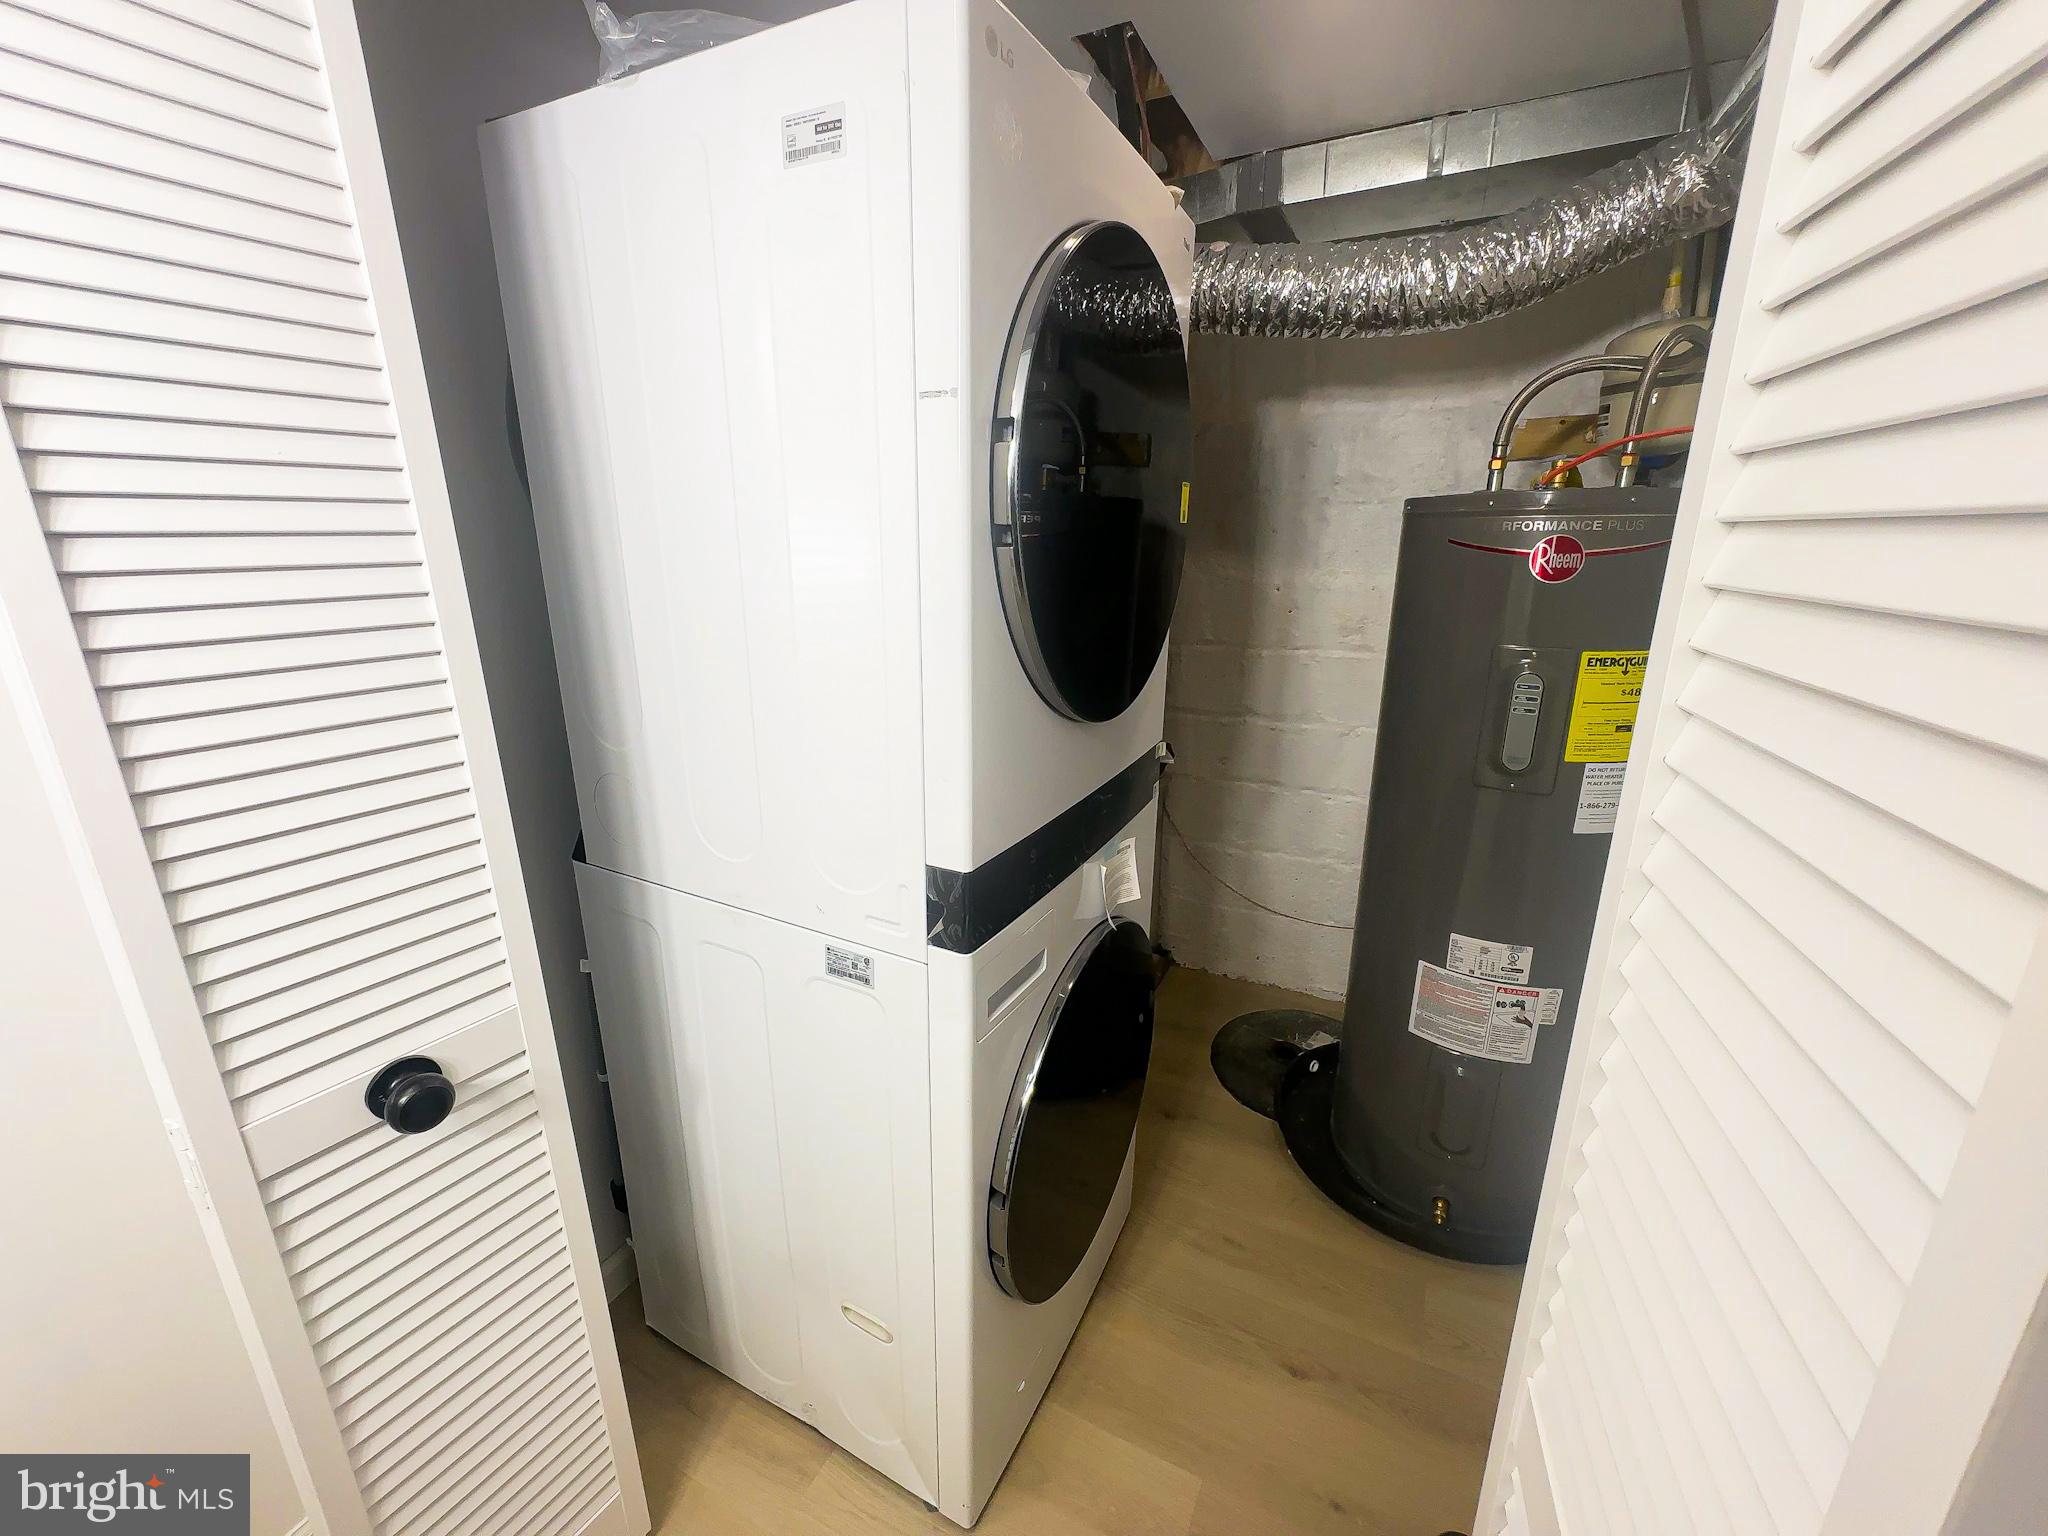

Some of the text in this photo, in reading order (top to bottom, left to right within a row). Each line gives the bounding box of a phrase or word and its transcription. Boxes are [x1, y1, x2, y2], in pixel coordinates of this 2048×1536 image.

[1607, 519, 1645, 531] PLUS
[1535, 536, 1582, 575] Rheem
[1506, 988, 1539, 998] DANGER
